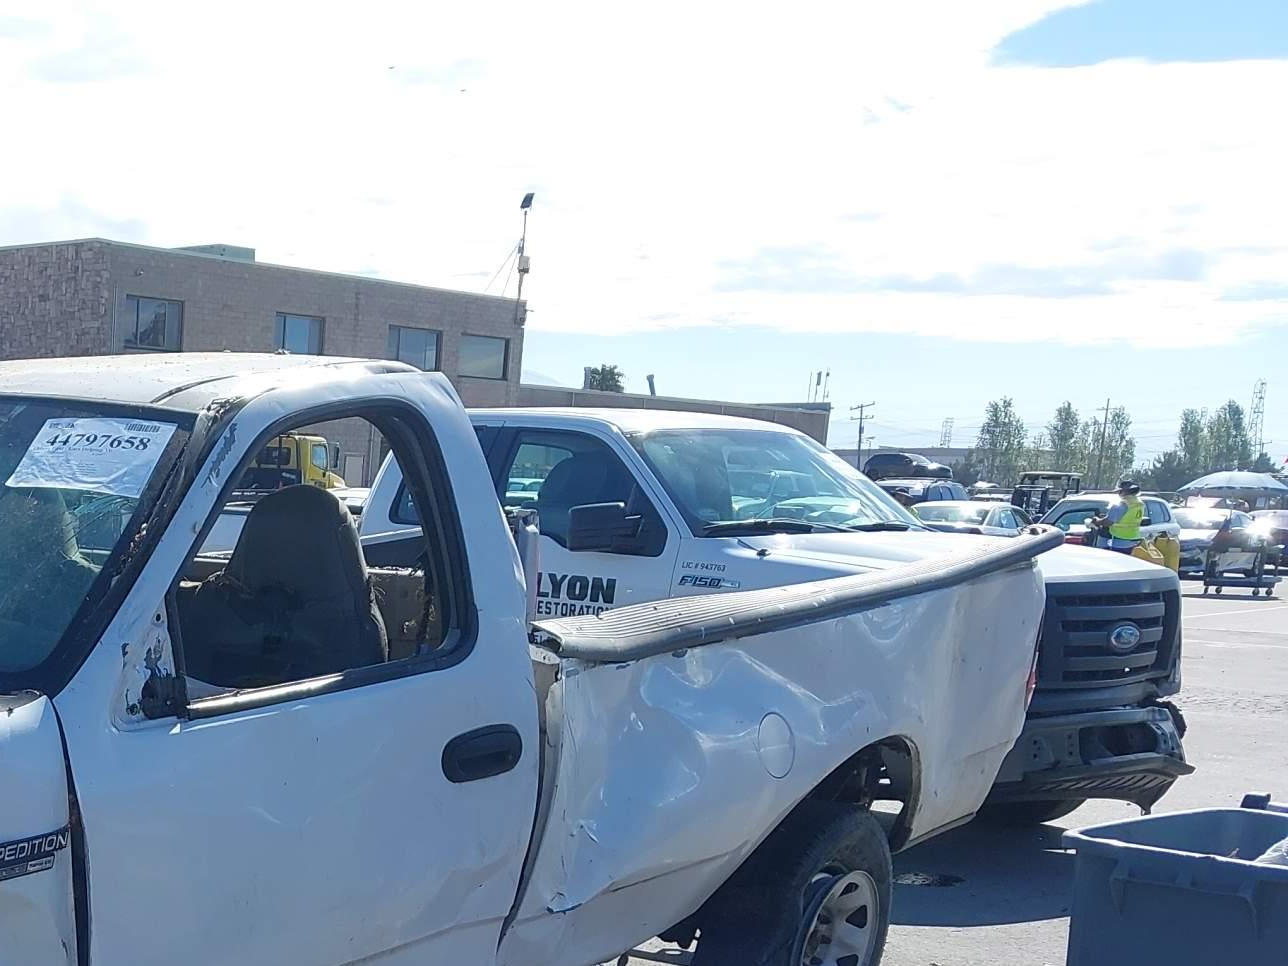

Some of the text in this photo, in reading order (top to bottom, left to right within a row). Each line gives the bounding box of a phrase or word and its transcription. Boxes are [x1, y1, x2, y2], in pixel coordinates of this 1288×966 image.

[46, 433, 151, 451] 44797658
[681, 561, 693, 569] LIC
[536, 571, 617, 604] LYON
